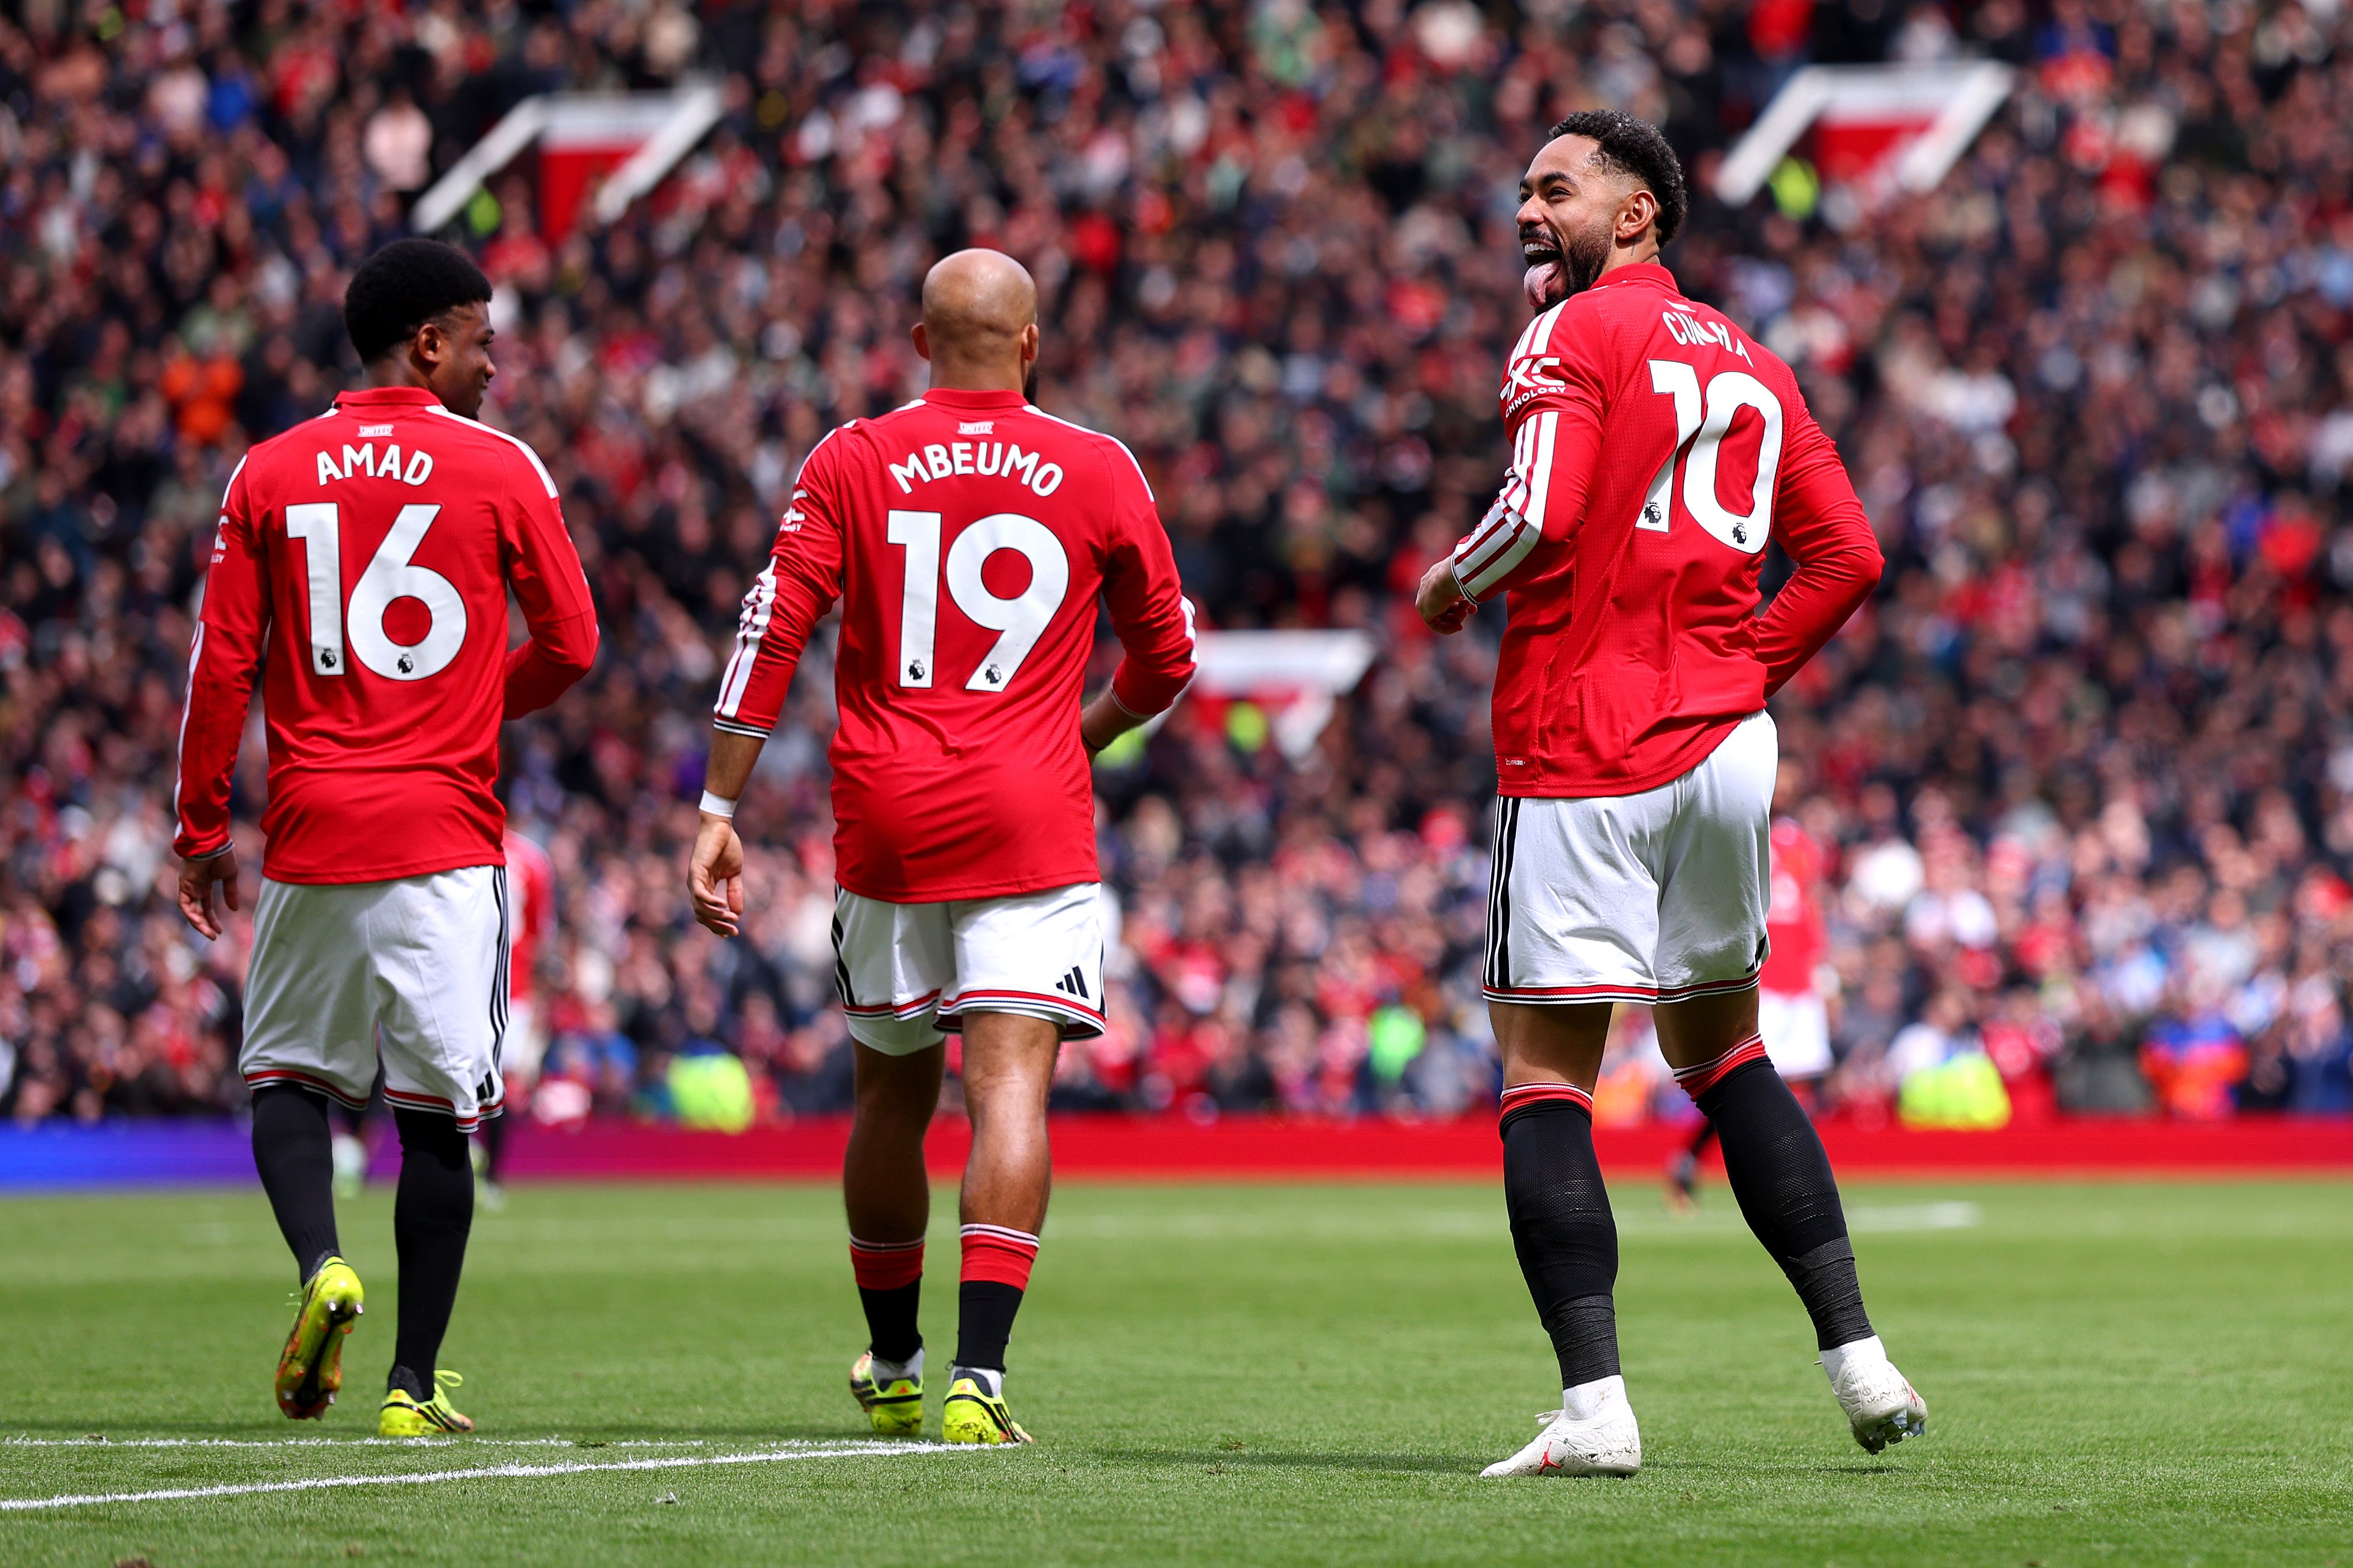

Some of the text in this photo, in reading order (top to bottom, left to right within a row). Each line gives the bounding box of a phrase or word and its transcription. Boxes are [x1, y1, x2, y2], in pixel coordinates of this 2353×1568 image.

[316, 442, 433, 486] AMAD
[888, 442, 1063, 497] MBEUMO
[1635, 359, 1783, 554] 10
[285, 502, 467, 681] 16
[887, 510, 1069, 693] 19
